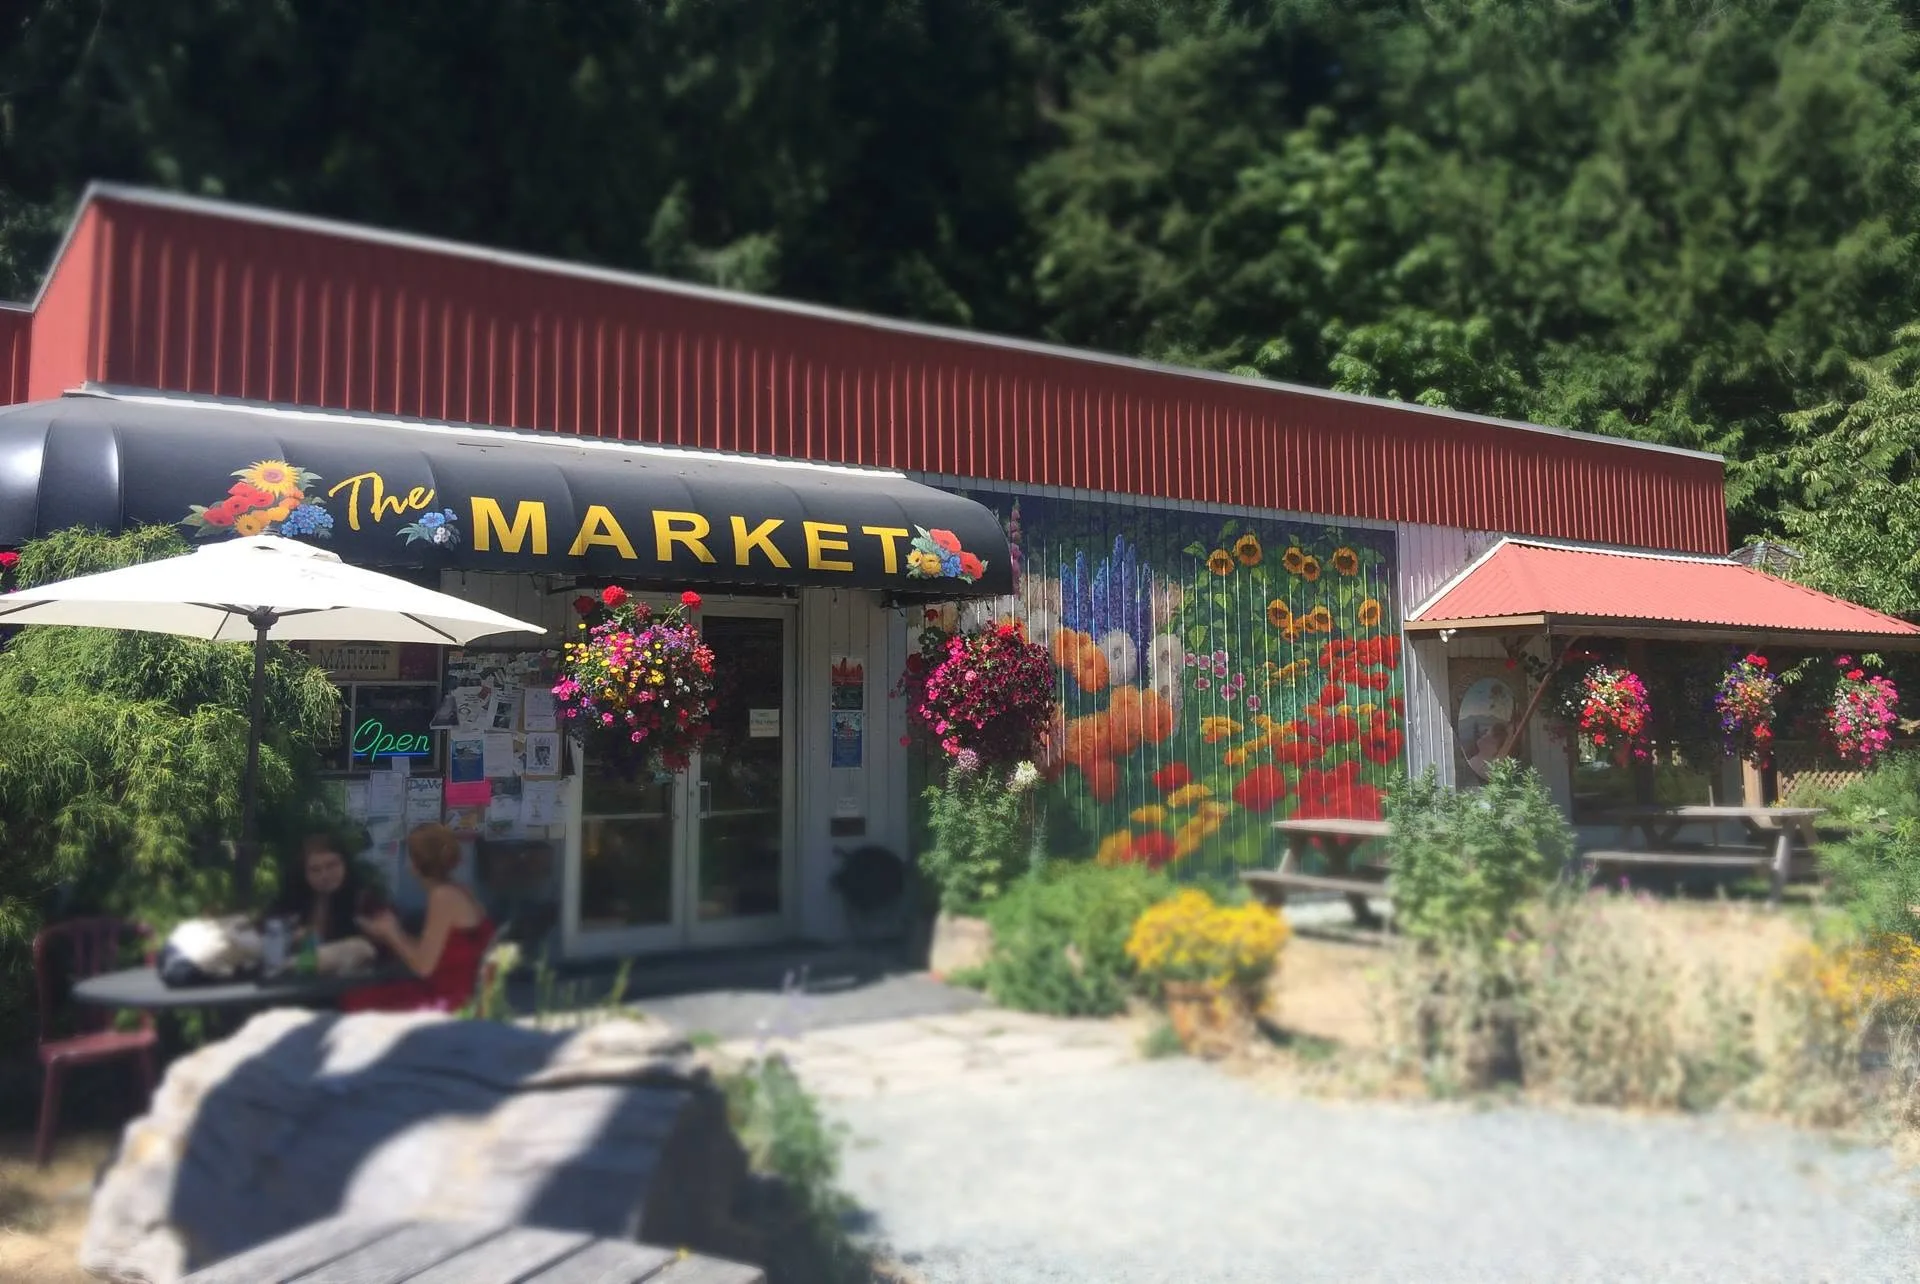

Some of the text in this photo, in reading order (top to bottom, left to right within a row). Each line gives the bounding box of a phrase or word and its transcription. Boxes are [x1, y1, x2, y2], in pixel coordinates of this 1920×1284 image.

[328, 471, 909, 574] The MARKET
[352, 718, 430, 762] Open
